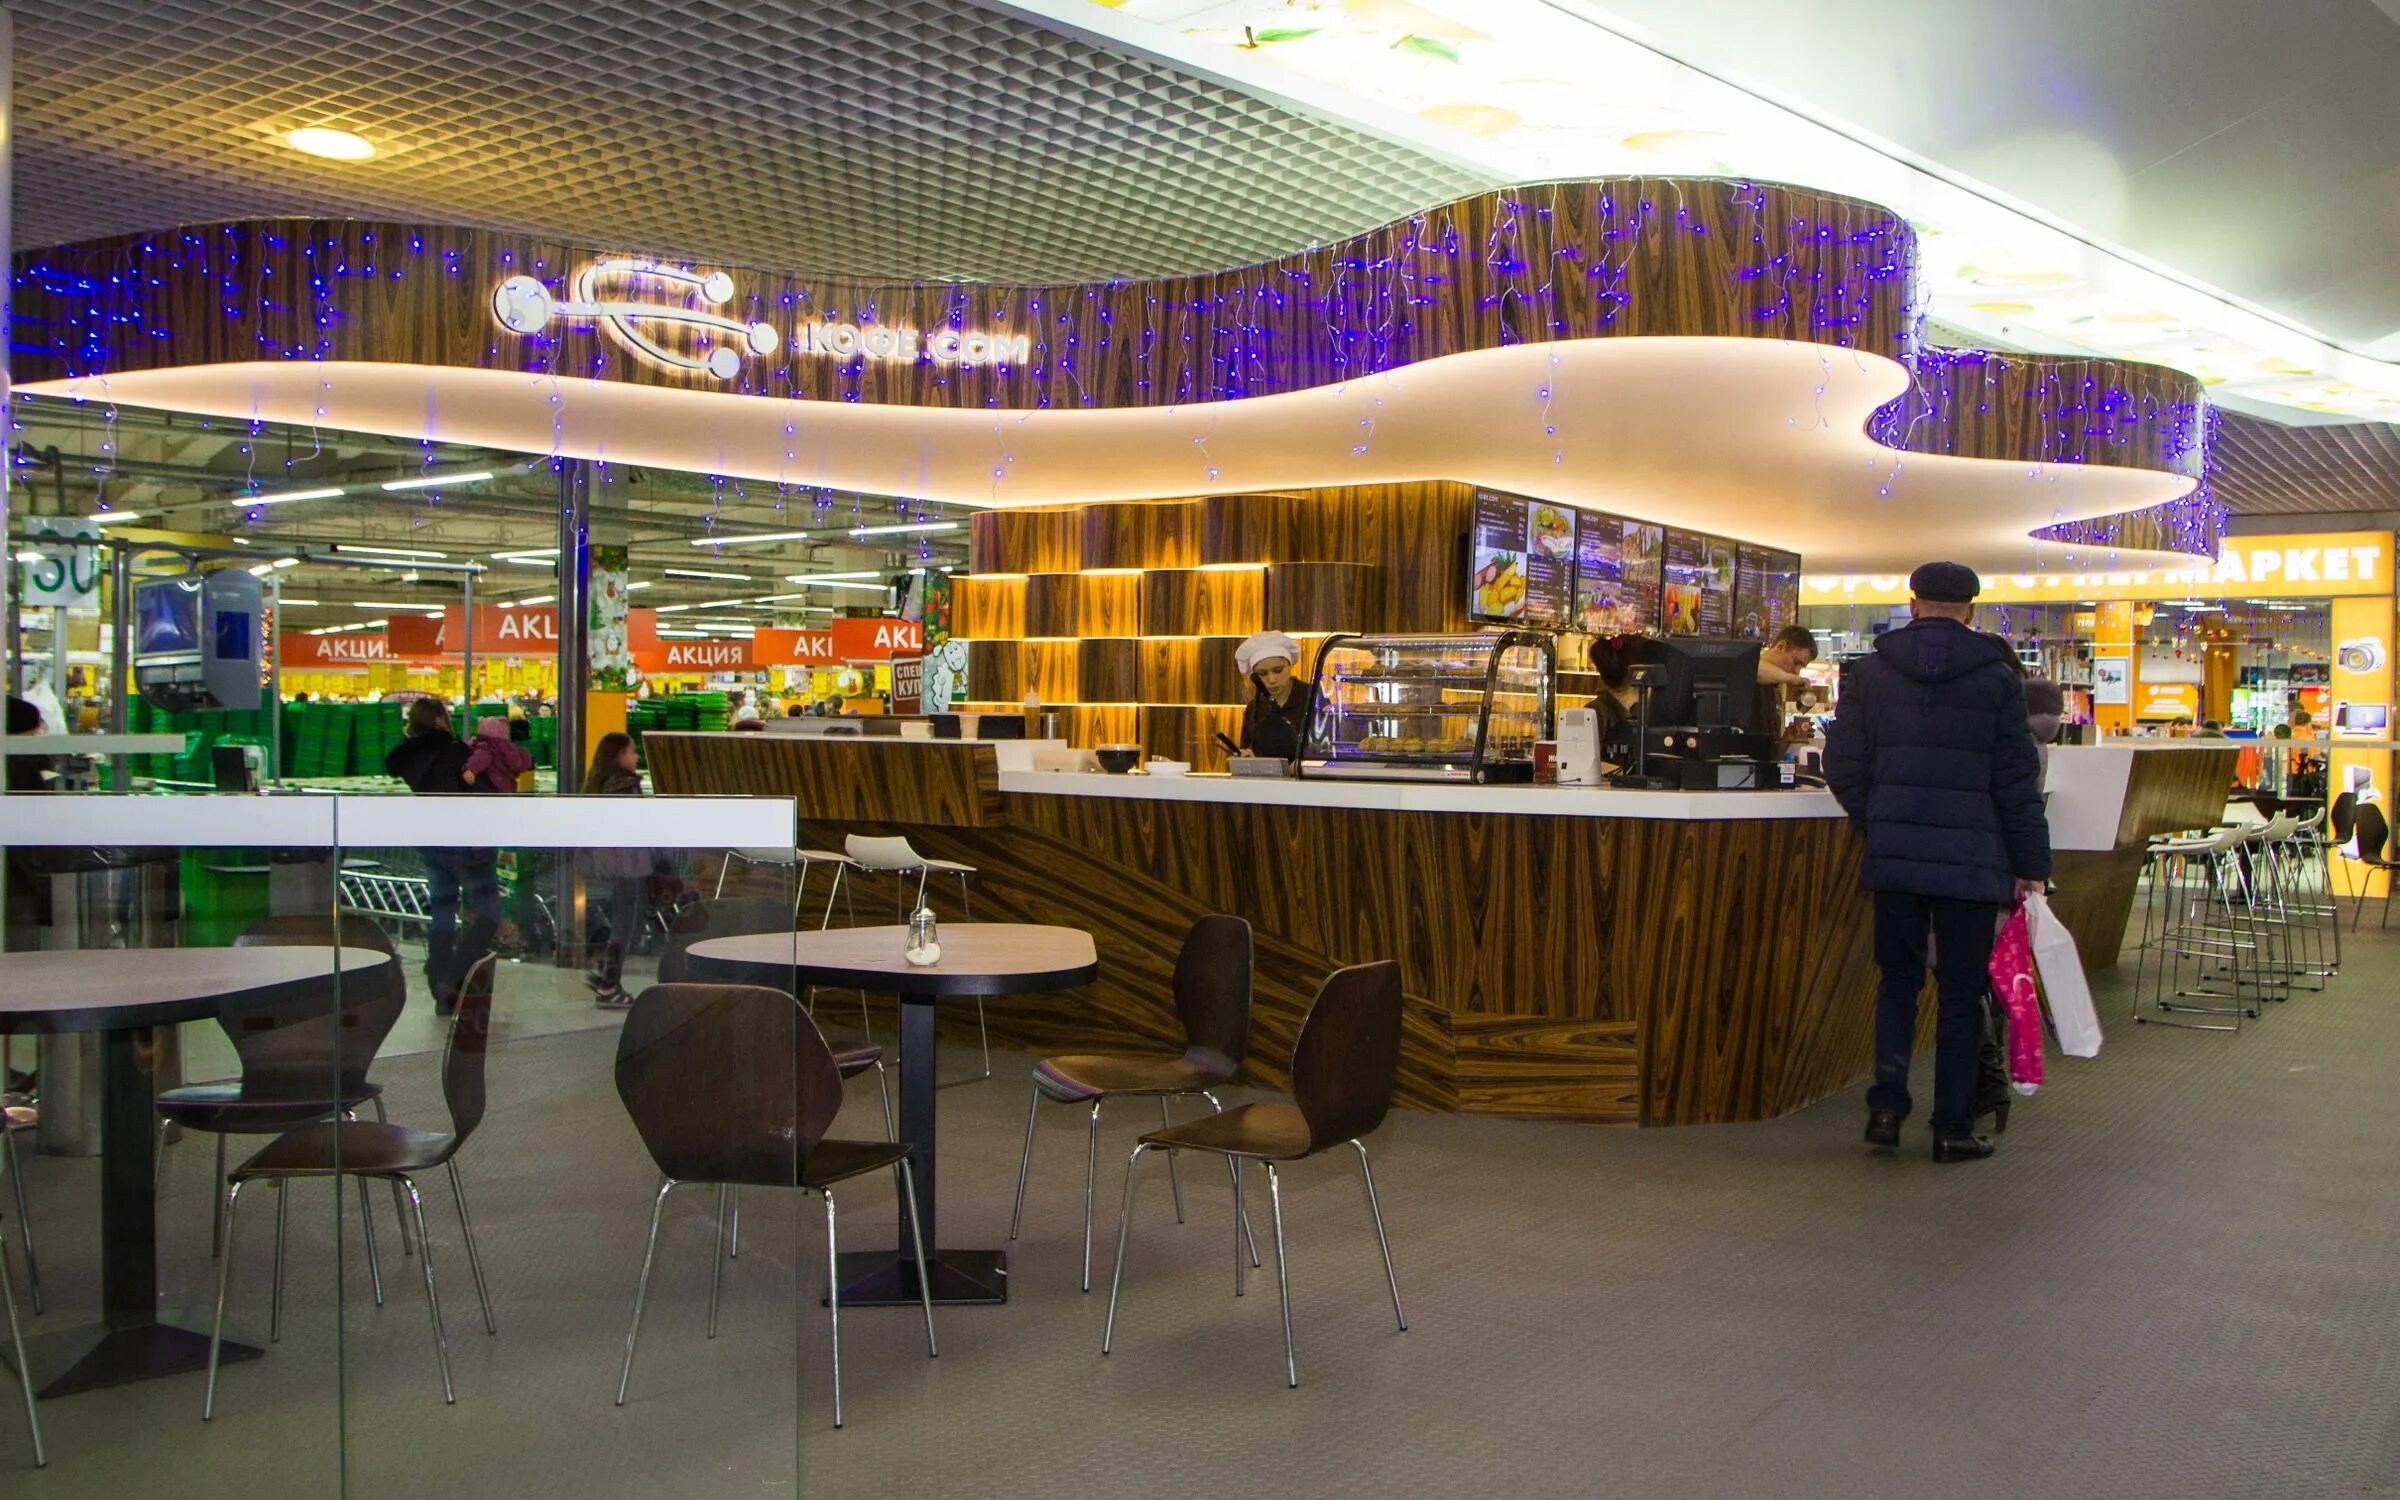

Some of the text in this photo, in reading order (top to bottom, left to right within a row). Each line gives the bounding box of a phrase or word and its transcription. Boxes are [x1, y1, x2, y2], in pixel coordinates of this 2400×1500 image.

[808, 322, 920, 359] КОФЕ
[666, 645, 744, 667] АКЦИЯ
[793, 636, 833, 657] АК
